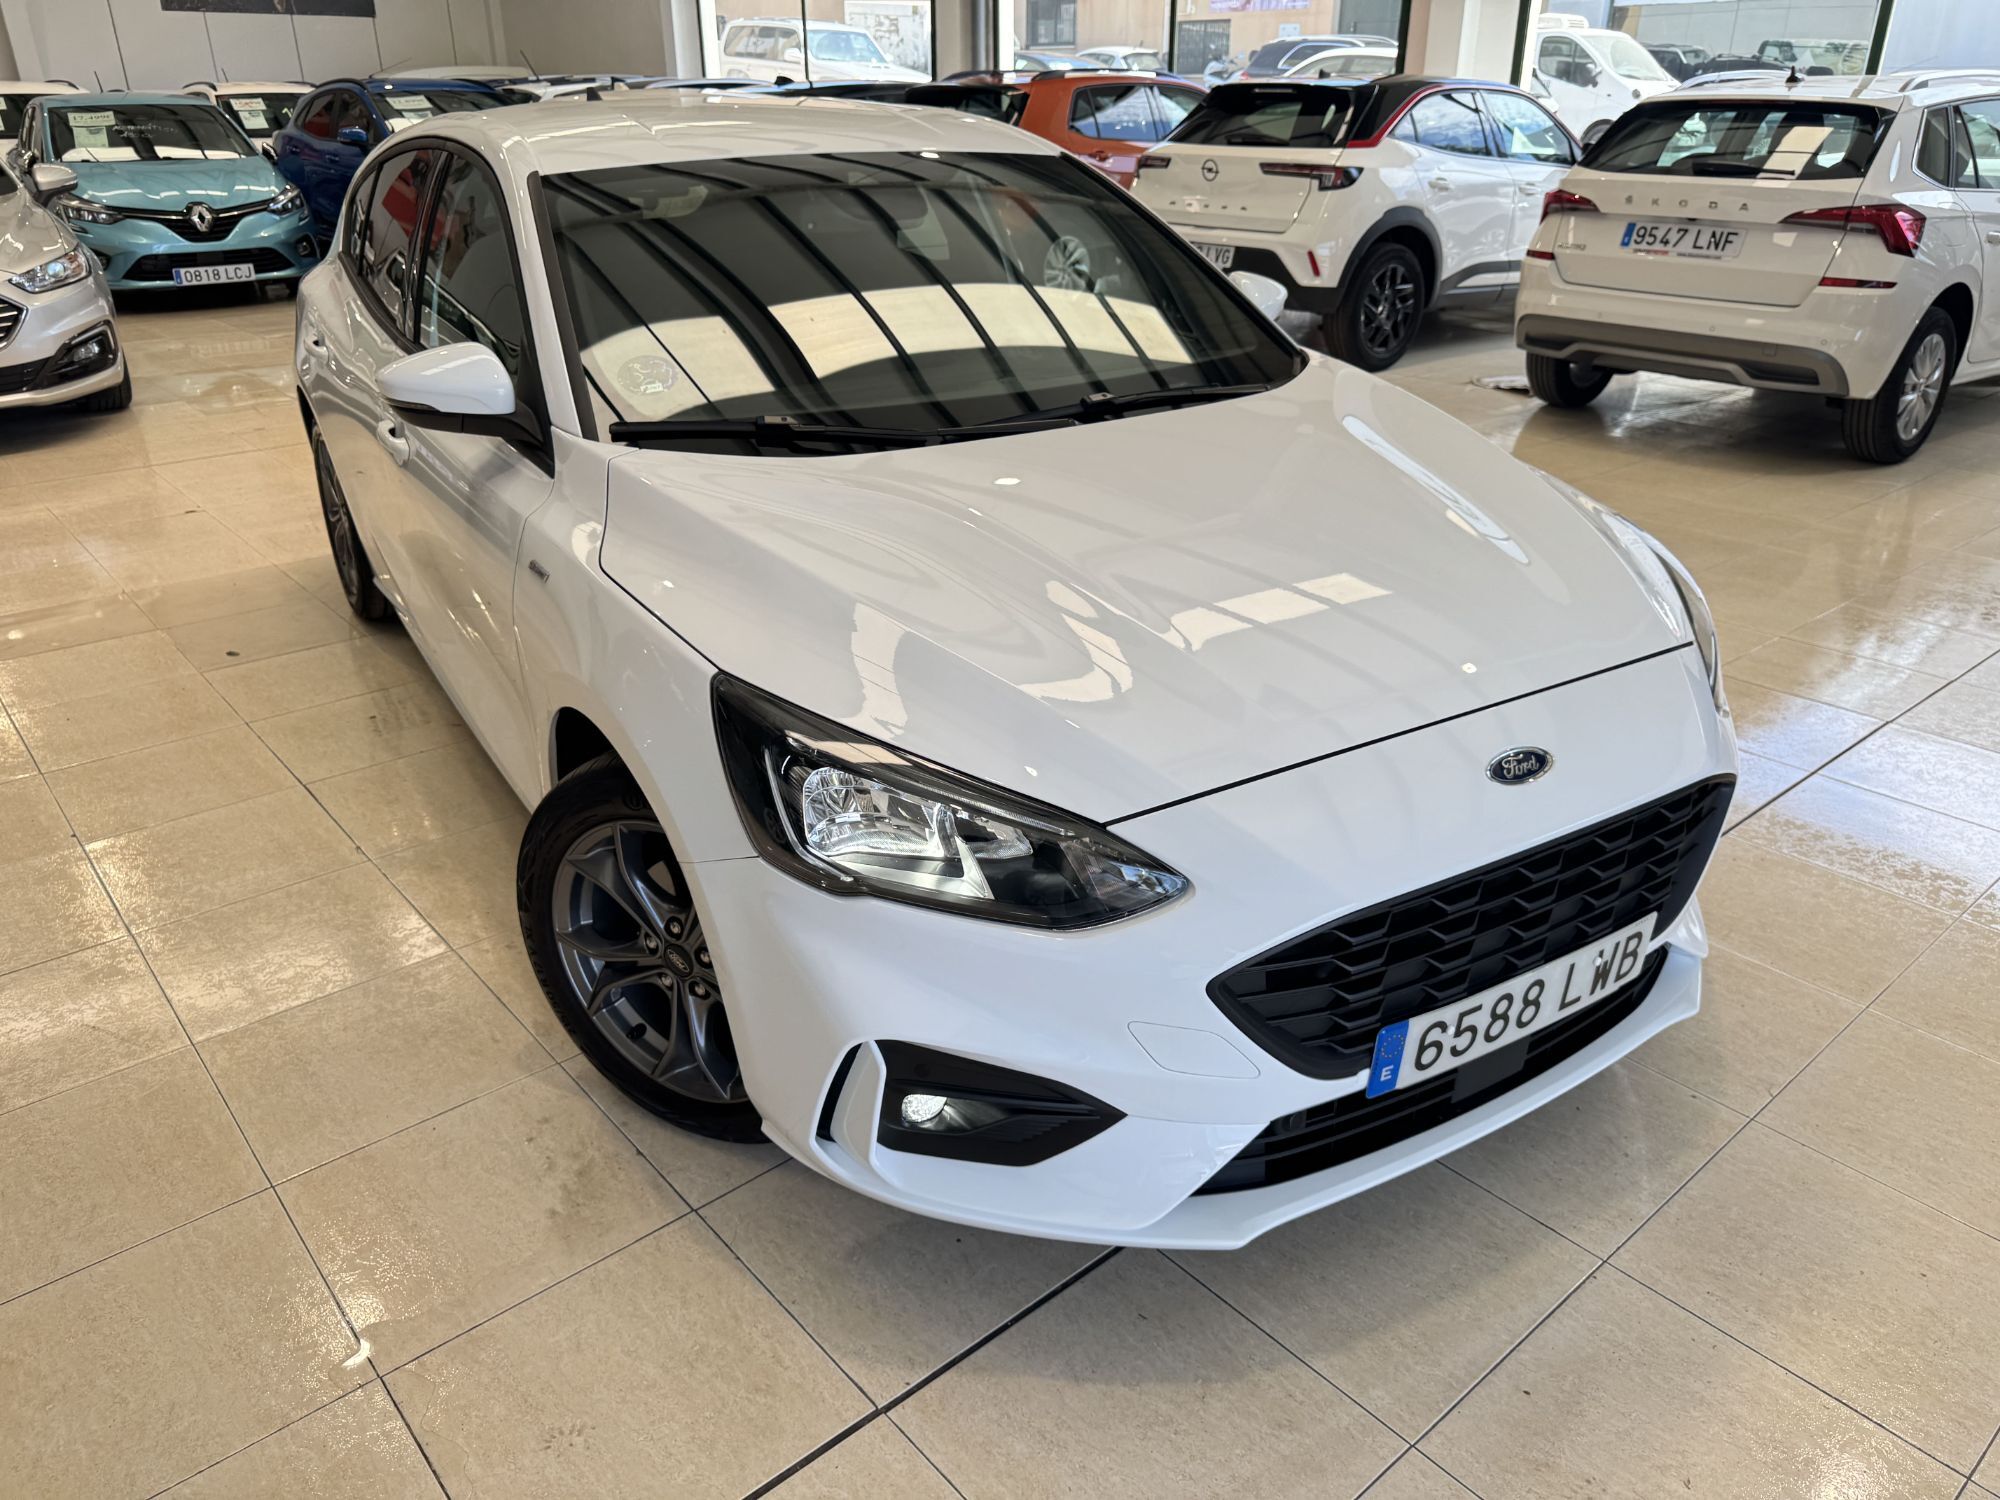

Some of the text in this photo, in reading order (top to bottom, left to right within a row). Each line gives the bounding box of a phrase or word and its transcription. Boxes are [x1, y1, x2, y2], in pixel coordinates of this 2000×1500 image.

[1633, 225, 1689, 248] 9547
[1692, 228, 1740, 252] LNF
[184, 265, 252, 284] 0818 LCJ
[1502, 753, 1540, 779] Ford
[1413, 930, 1644, 1072] 6588 LWB
[1379, 1064, 1393, 1082] E
